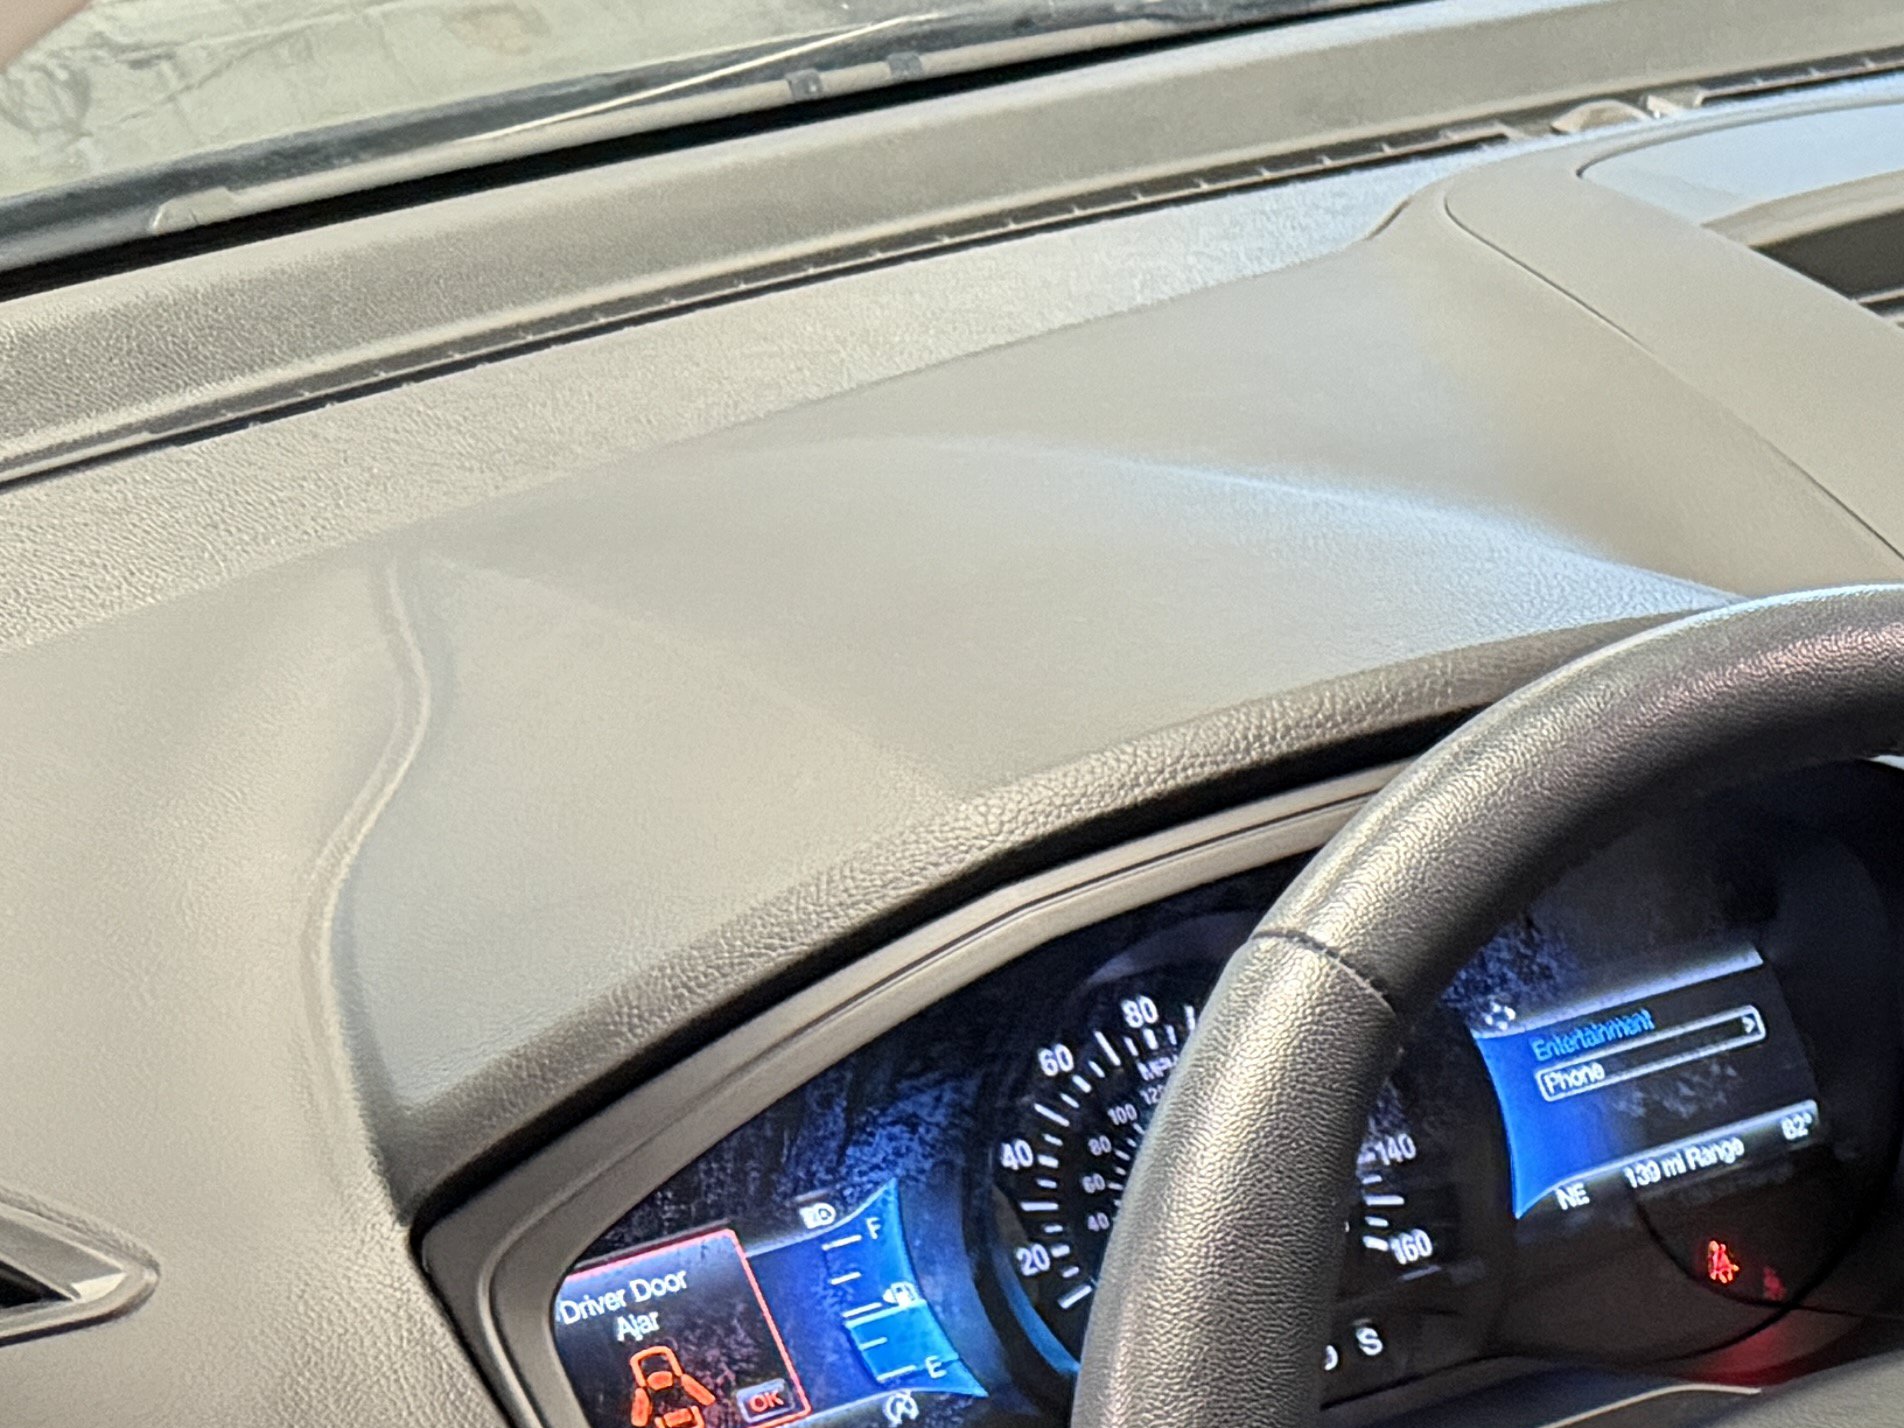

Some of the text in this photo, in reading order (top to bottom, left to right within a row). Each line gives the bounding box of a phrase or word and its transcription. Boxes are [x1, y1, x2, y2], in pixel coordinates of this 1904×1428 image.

[1120, 995, 1158, 1029] 80
[1530, 1008, 1655, 1062] Entertainment
[1038, 1043, 1074, 1076] 60
[1543, 1061, 1606, 1094] Phone
[1107, 1102, 1138, 1127] 100
[1001, 1139, 1034, 1172] 40
[1088, 1135, 1112, 1157] 80
[1374, 1133, 1416, 1166] 140
[1623, 1136, 1745, 1189] 139 mi Range
[1082, 1173, 1106, 1194] 60
[1553, 1182, 1590, 1210] NE
[866, 1217, 883, 1240] F
[1087, 1212, 1110, 1232] 40
[1016, 1243, 1051, 1277] 20
[1390, 1230, 1433, 1264] 160
[560, 1269, 688, 1325] Driver Door
[615, 1311, 660, 1343] Ajar
[1356, 1326, 1383, 1356] S
[924, 1355, 947, 1379] E
[749, 1391, 784, 1413] OK
